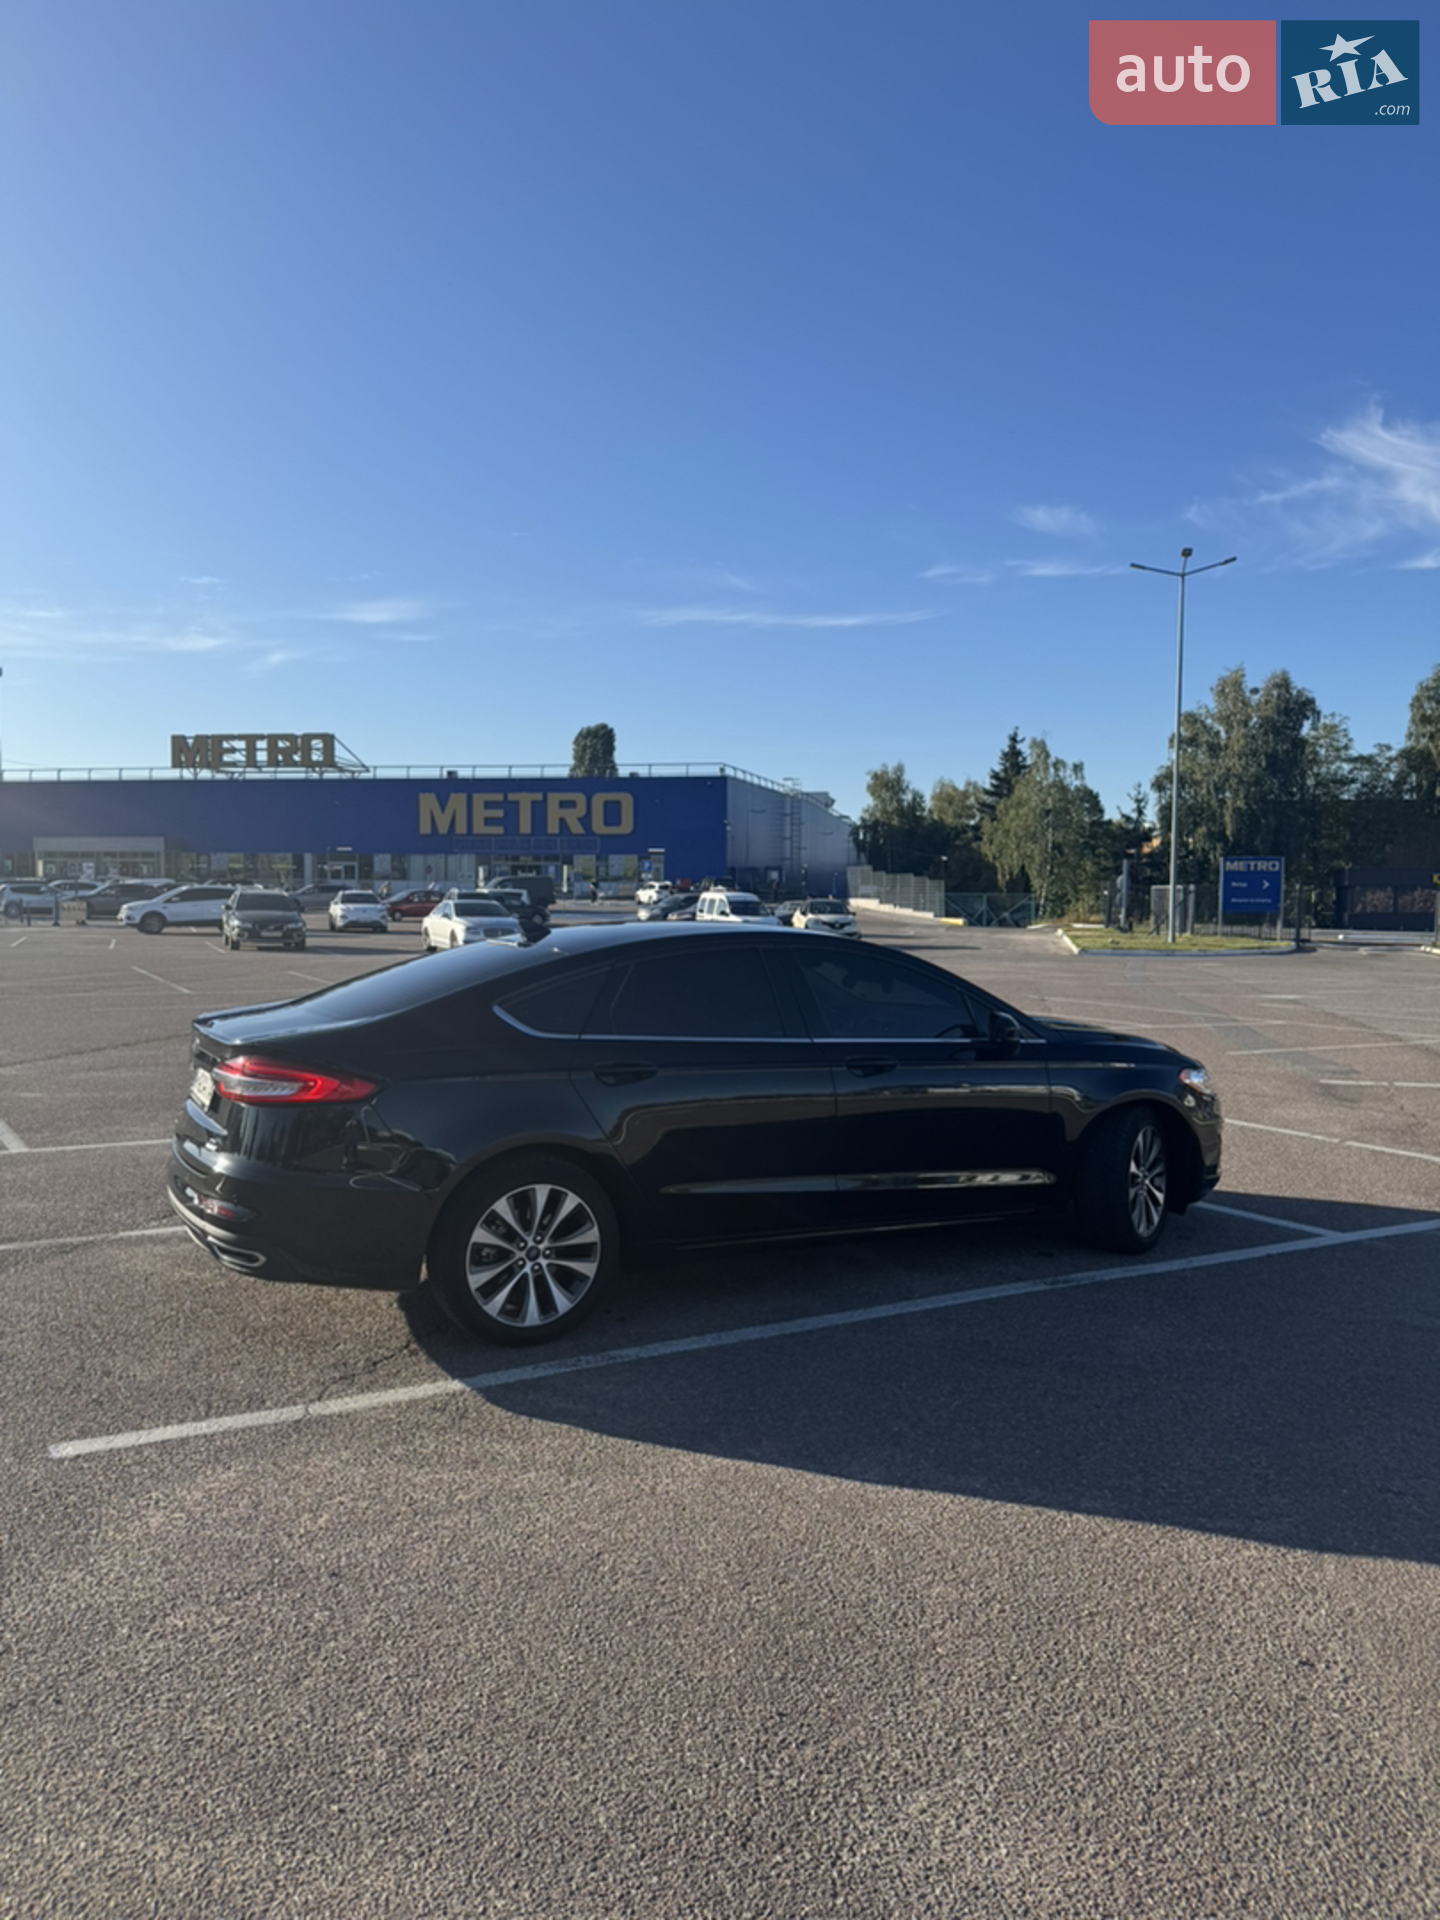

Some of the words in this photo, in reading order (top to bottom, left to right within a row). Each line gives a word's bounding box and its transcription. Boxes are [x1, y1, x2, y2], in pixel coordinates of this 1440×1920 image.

[171, 733, 336, 768] METRO
[418, 792, 635, 836] METRO
[1225, 860, 1280, 872] METRO
